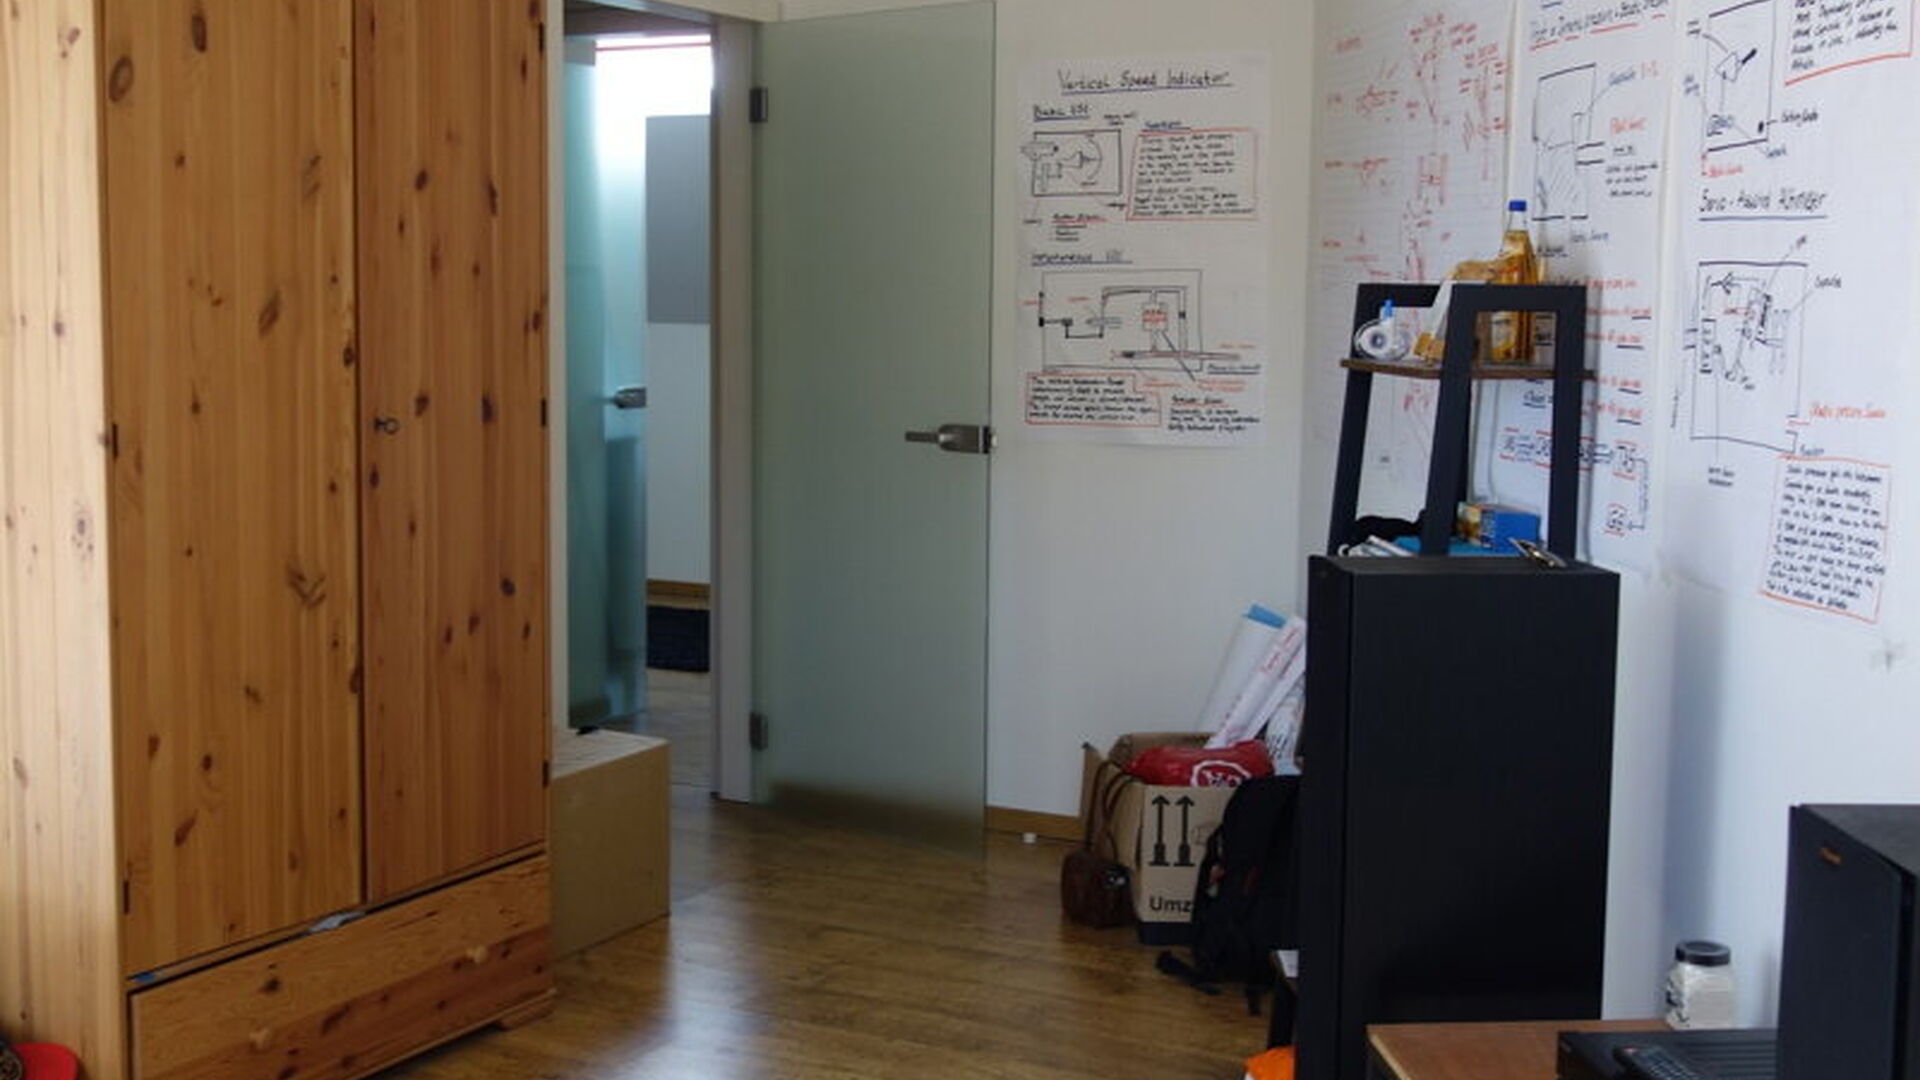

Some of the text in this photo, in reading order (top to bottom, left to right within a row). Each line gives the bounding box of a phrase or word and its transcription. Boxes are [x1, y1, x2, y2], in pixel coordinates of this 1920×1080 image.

[1057, 68, 1230, 90] Vertical Speed Indicator
